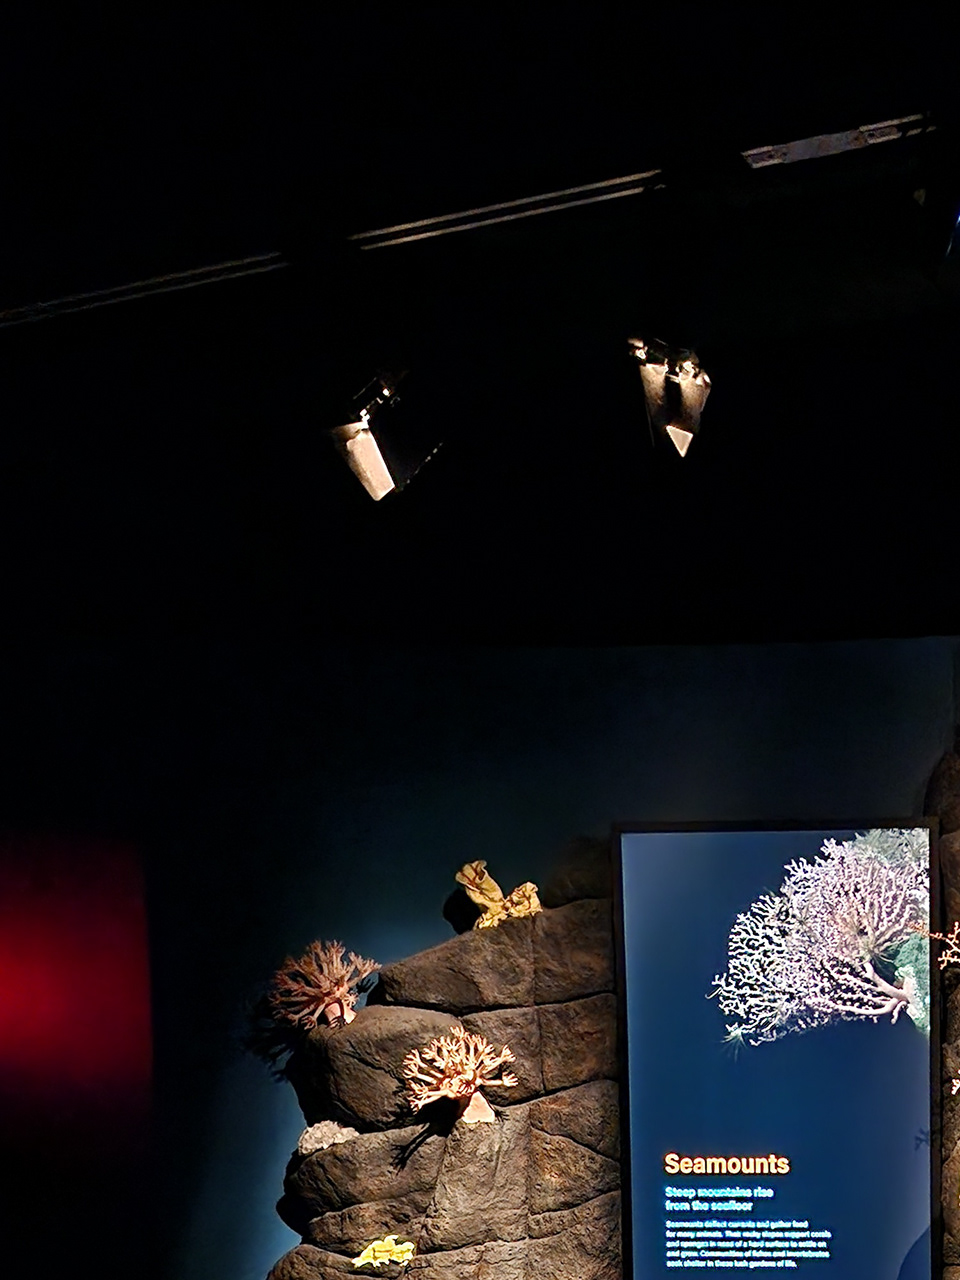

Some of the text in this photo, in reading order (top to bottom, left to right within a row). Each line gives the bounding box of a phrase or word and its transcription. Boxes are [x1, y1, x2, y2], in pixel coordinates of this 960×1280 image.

[665, 1153, 791, 1174] Seamounts
[666, 1187, 773, 1199] Steep mountains rise
[665, 1200, 753, 1210] from the seafloor
[666, 1220, 705, 1228] Seamounts
[757, 1221, 769, 1229] and
[770, 1220, 793, 1229] gather
[792, 1220, 808, 1228] food
[677, 1231, 695, 1239] many
[784, 1231, 809, 1239] support
[811, 1230, 831, 1238] corals
[666, 1240, 679, 1248] and
[667, 1250, 680, 1258] and
[700, 1250, 745, 1258] Communities
[772, 1250, 786, 1258] and
[787, 1250, 829, 1258] invertebrates
[667, 1260, 683, 1268] seek
[684, 1260, 708, 1268] shelter
[734, 1260, 748, 1268] lush
[749, 1260, 776, 1268] gardens
